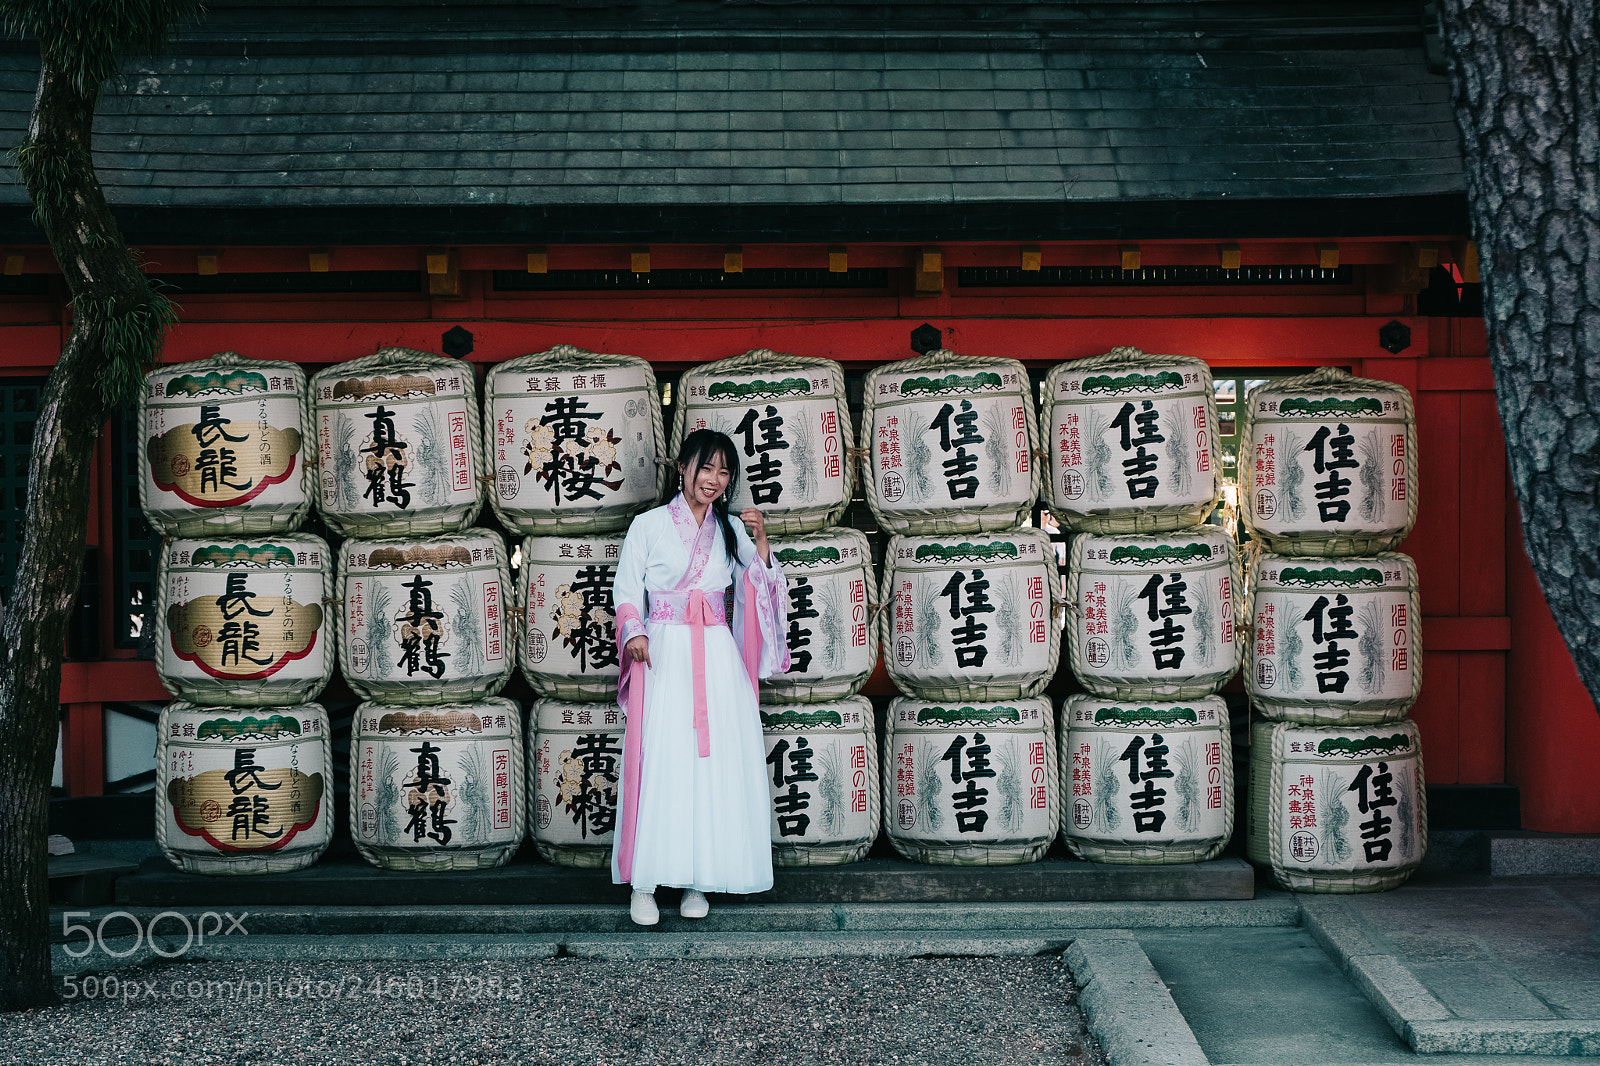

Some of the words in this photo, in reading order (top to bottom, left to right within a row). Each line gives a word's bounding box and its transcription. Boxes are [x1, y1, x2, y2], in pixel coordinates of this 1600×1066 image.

[526, 377, 561, 392] 登録
[573, 374, 606, 389] 商標
[191, 405, 252, 494] 長龍
[361, 405, 416, 510] 真鶴
[452, 416, 468, 485] 芳醇清酒
[540, 396, 625, 506] 黄桜
[735, 405, 789, 505] 住吉
[930, 399, 984, 500] 住吉
[1110, 400, 1165, 500] 住吉
[1304, 423, 1360, 523] 住吉
[559, 544, 593, 558] 登録
[216, 573, 274, 666] 長龍
[396, 574, 451, 679] 真鶴
[486, 587, 500, 655] 芳醇清酒
[940, 569, 995, 669] 住吉
[1138, 572, 1192, 670] 住吉
[1303, 594, 1358, 694] 住吉
[561, 710, 592, 725] 登録
[224, 748, 283, 841] 長龍
[402, 742, 457, 845] 真鶴
[496, 754, 509, 824] 芳醇清酒
[766, 736, 818, 837] 住吉
[941, 732, 996, 833] 住吉
[1119, 733, 1174, 833] 住吉
[1347, 762, 1397, 863] 住吉
